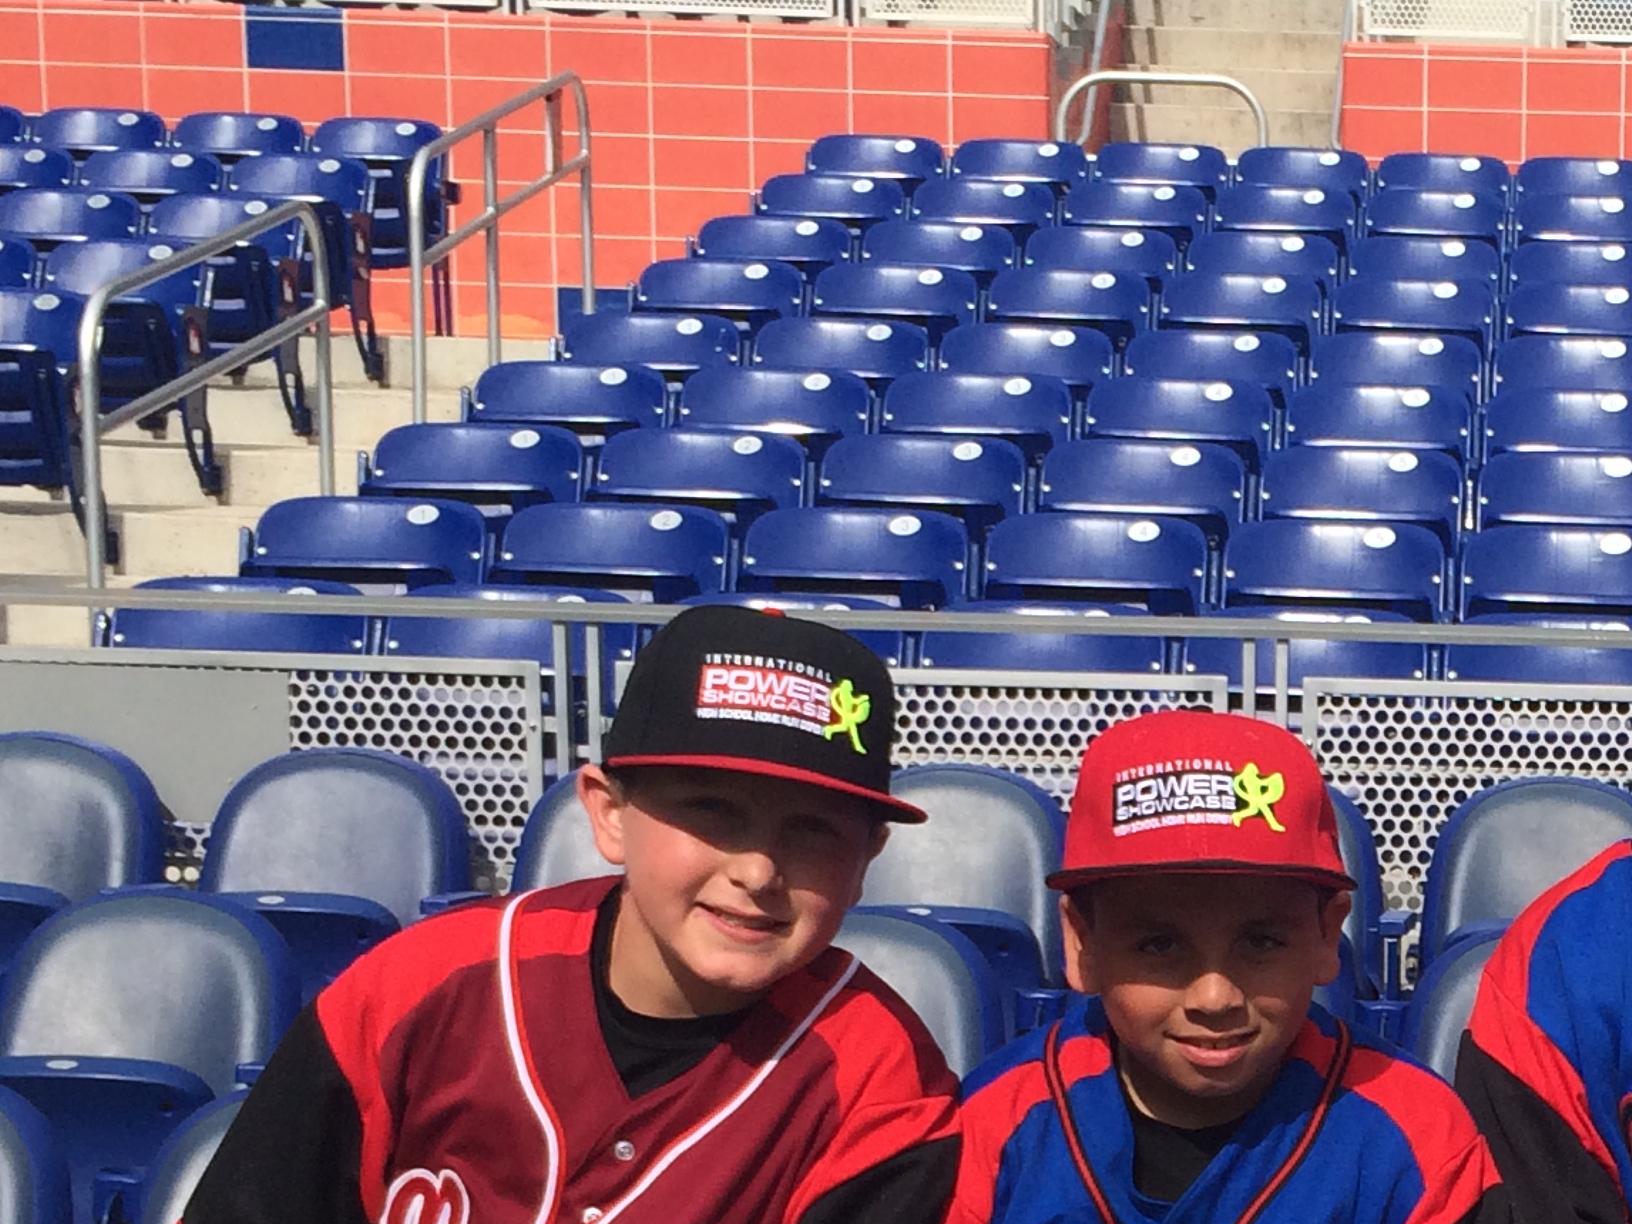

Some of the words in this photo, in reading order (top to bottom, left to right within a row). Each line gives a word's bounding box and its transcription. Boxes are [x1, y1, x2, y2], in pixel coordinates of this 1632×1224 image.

[705, 652, 833, 683] INTERNATIONAL
[705, 668, 832, 707] POWER
[702, 688, 831, 723] SHOWCASE
[1114, 758, 1234, 783] INTERNATIONAL
[1116, 773, 1235, 807] POWER
[1115, 796, 1237, 821] SHOWCASE
